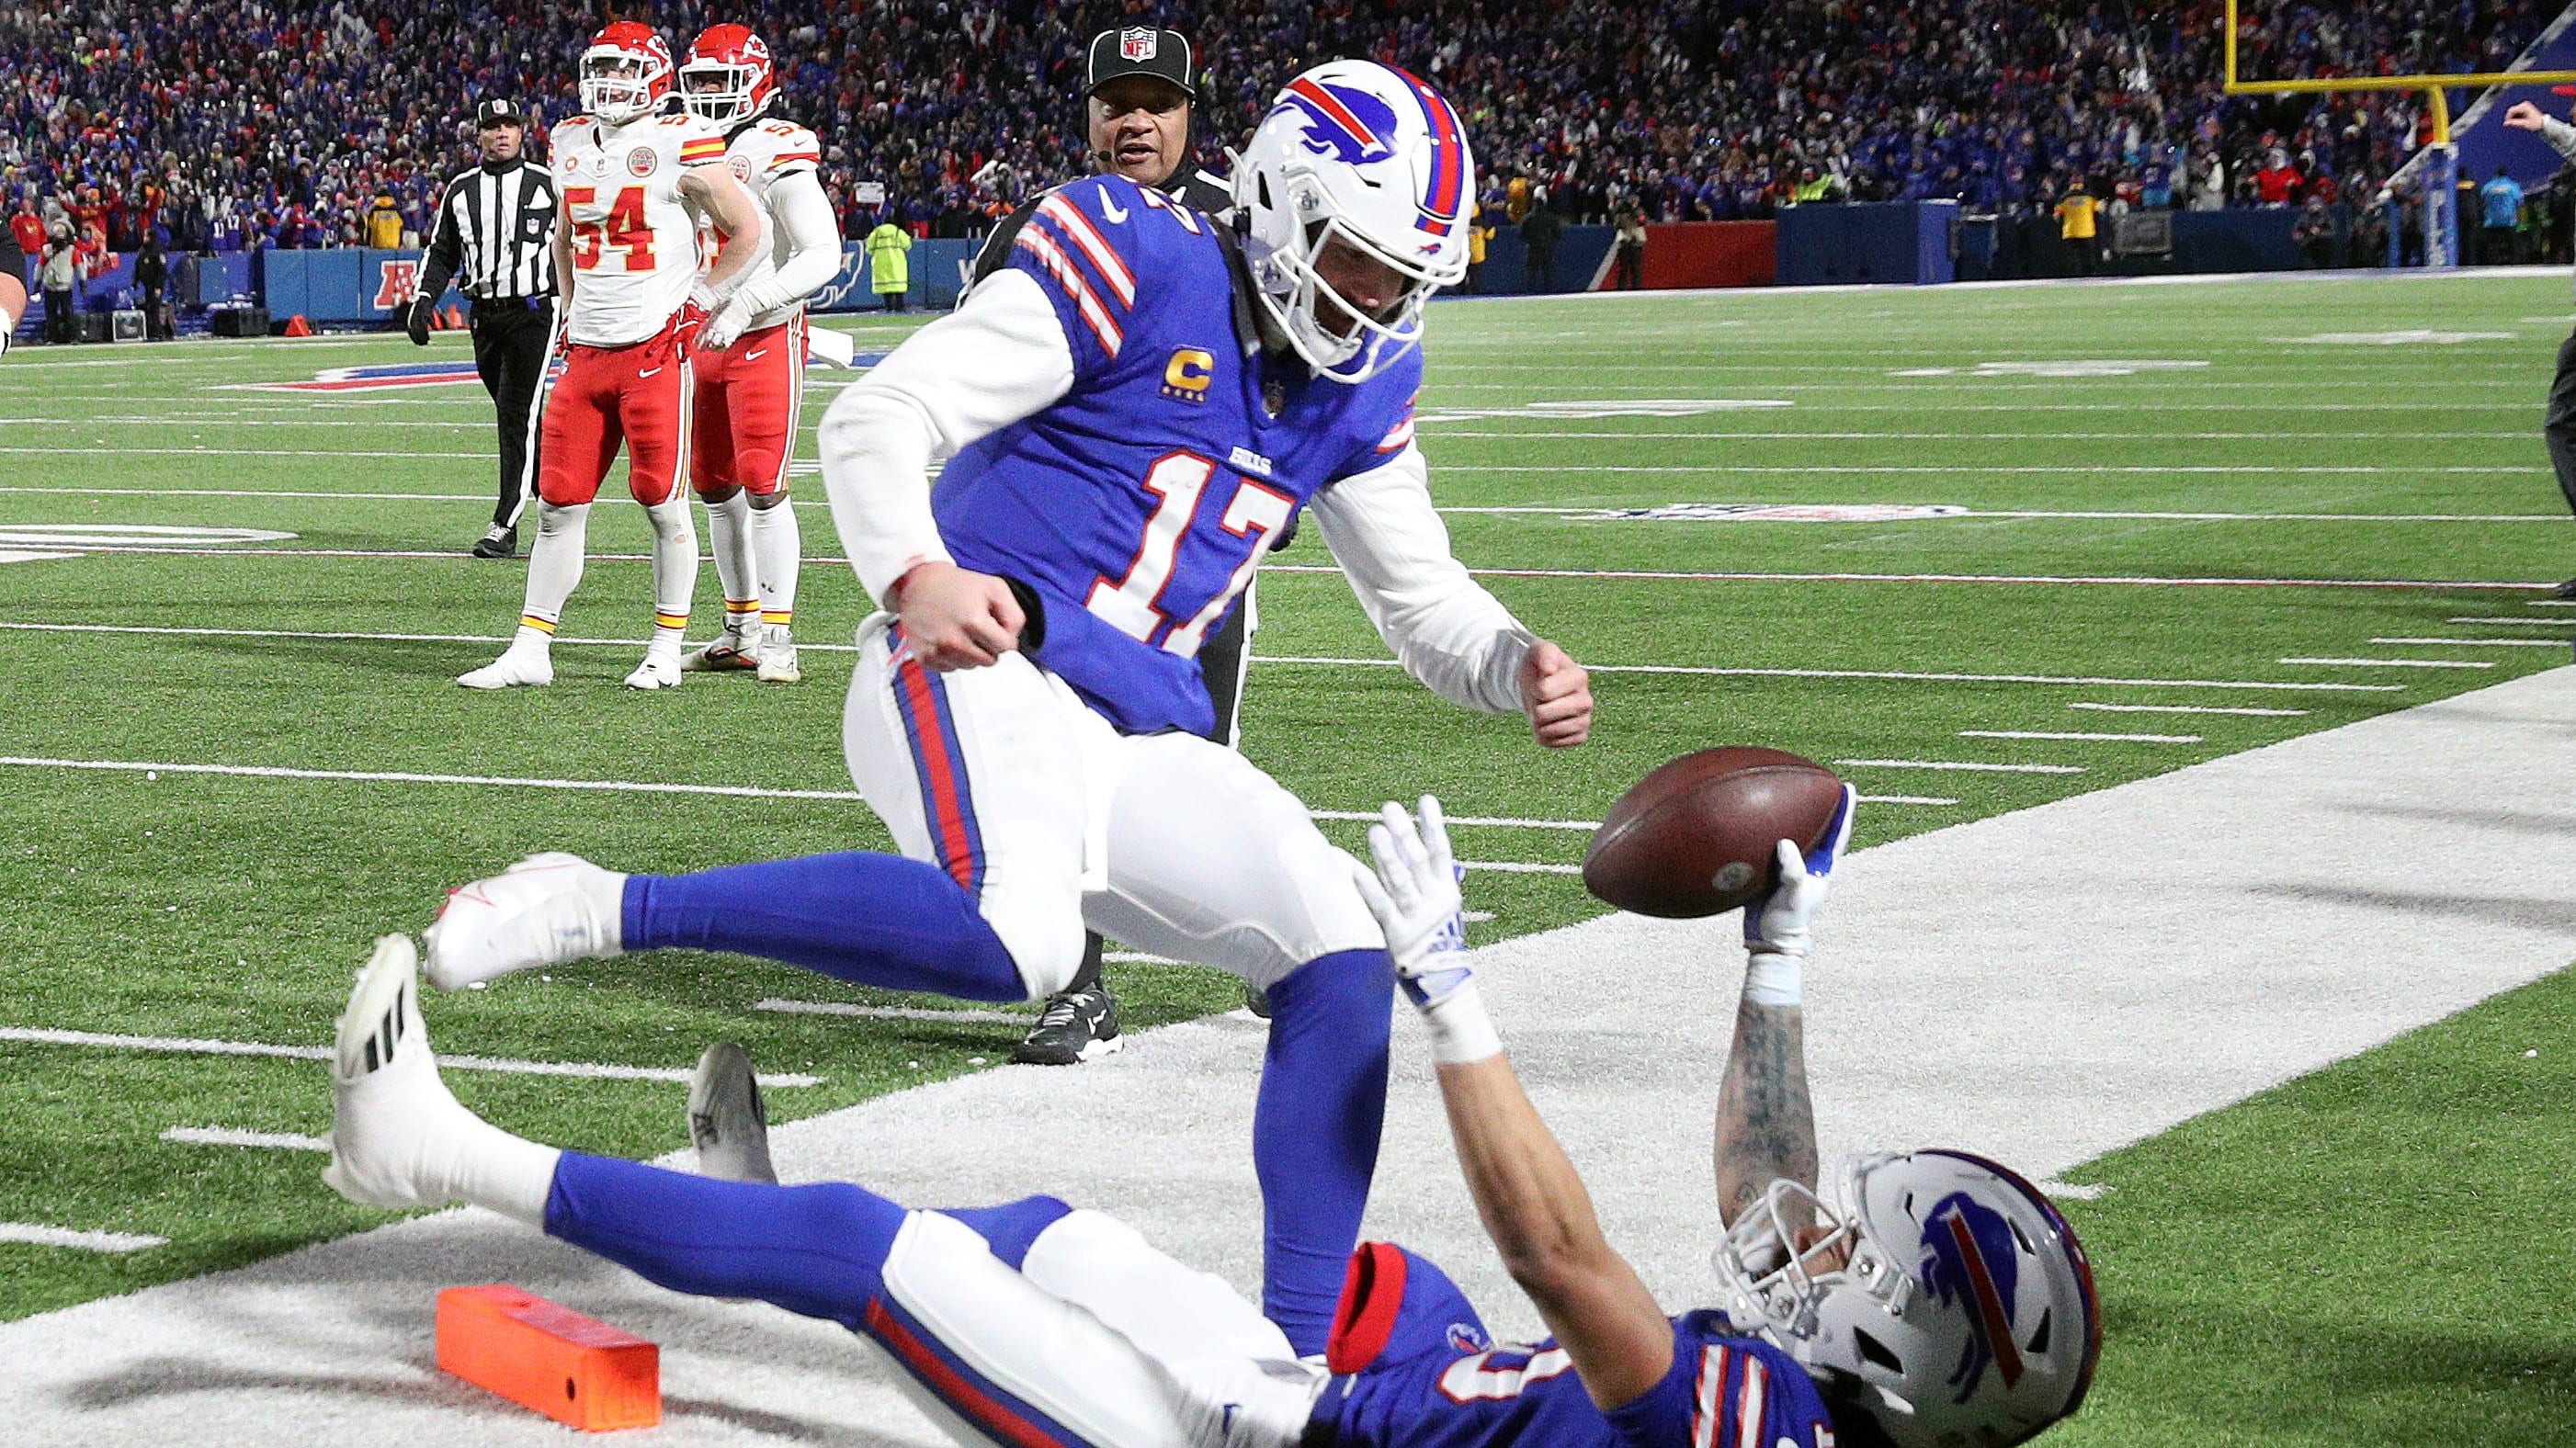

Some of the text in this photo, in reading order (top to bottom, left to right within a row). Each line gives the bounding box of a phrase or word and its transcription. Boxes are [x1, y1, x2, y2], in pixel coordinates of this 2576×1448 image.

[1123, 40, 1154, 56] NFL
[562, 186, 657, 272] 54
[1164, 349, 1214, 392] C
[1084, 447, 1298, 660] 17
